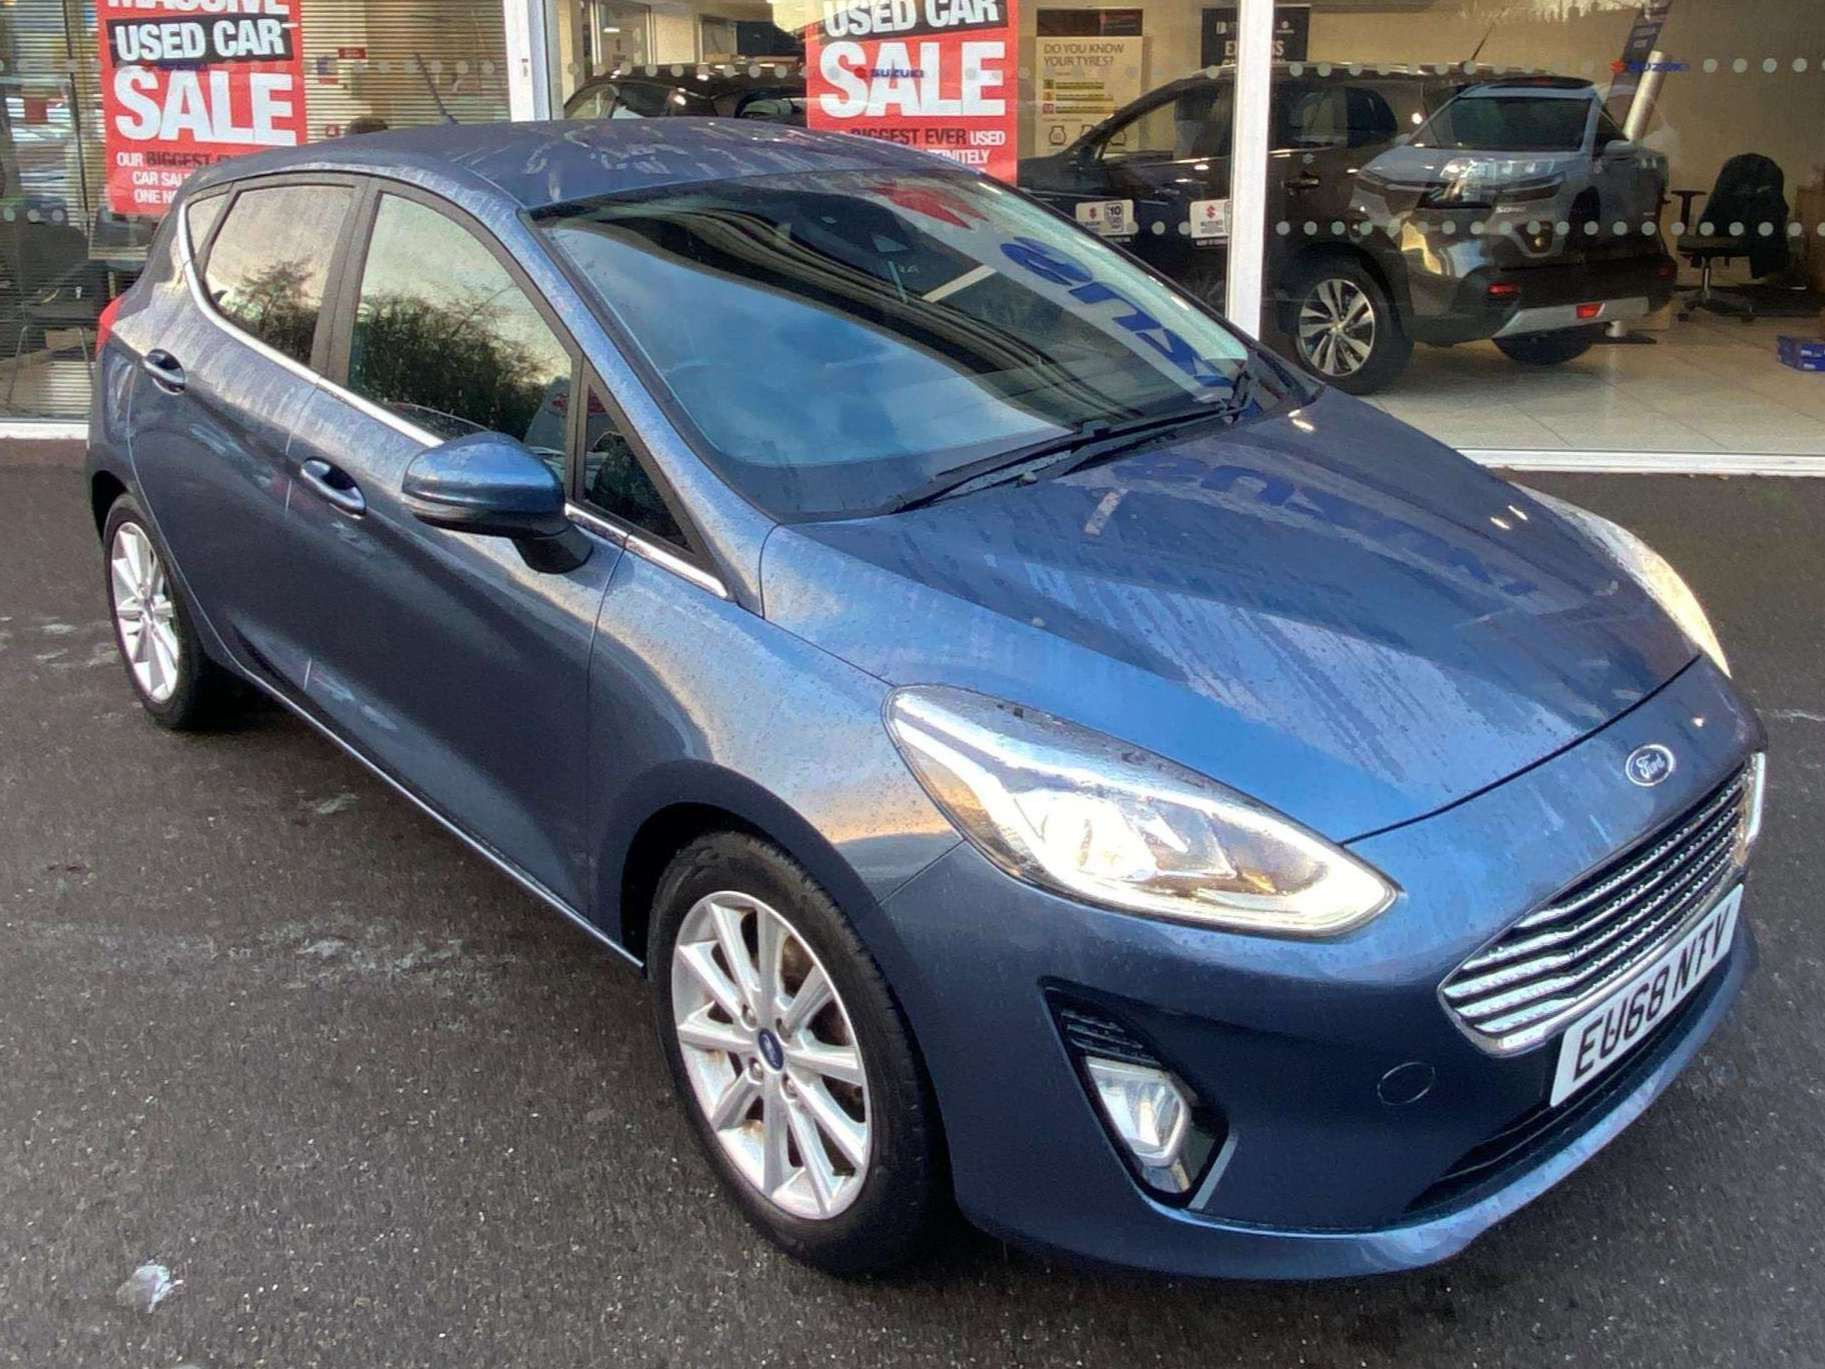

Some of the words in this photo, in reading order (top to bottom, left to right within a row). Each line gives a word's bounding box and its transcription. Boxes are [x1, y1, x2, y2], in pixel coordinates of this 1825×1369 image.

[823, 0, 917, 37] USED
[925, 0, 999, 28] CAR
[115, 22, 206, 61] USED
[212, 18, 285, 57] CAR
[1043, 43, 1061, 54] DO
[1062, 43, 1086, 54] YOU
[1088, 43, 1125, 54] KNOW
[1043, 55, 1074, 66] YOUR
[820, 41, 1006, 118] SALE
[870, 68, 924, 78] SUZUKI
[113, 64, 297, 147] SALE
[924, 128, 967, 145] EVER
[970, 131, 1006, 146] USED
[116, 151, 144, 167] OUR
[146, 151, 212, 166] BIGGEST
[132, 171, 158, 186] CAR
[134, 188, 161, 204] ONE
[1573, 965, 1671, 1082] EU68
[1672, 905, 1732, 999] NTV
